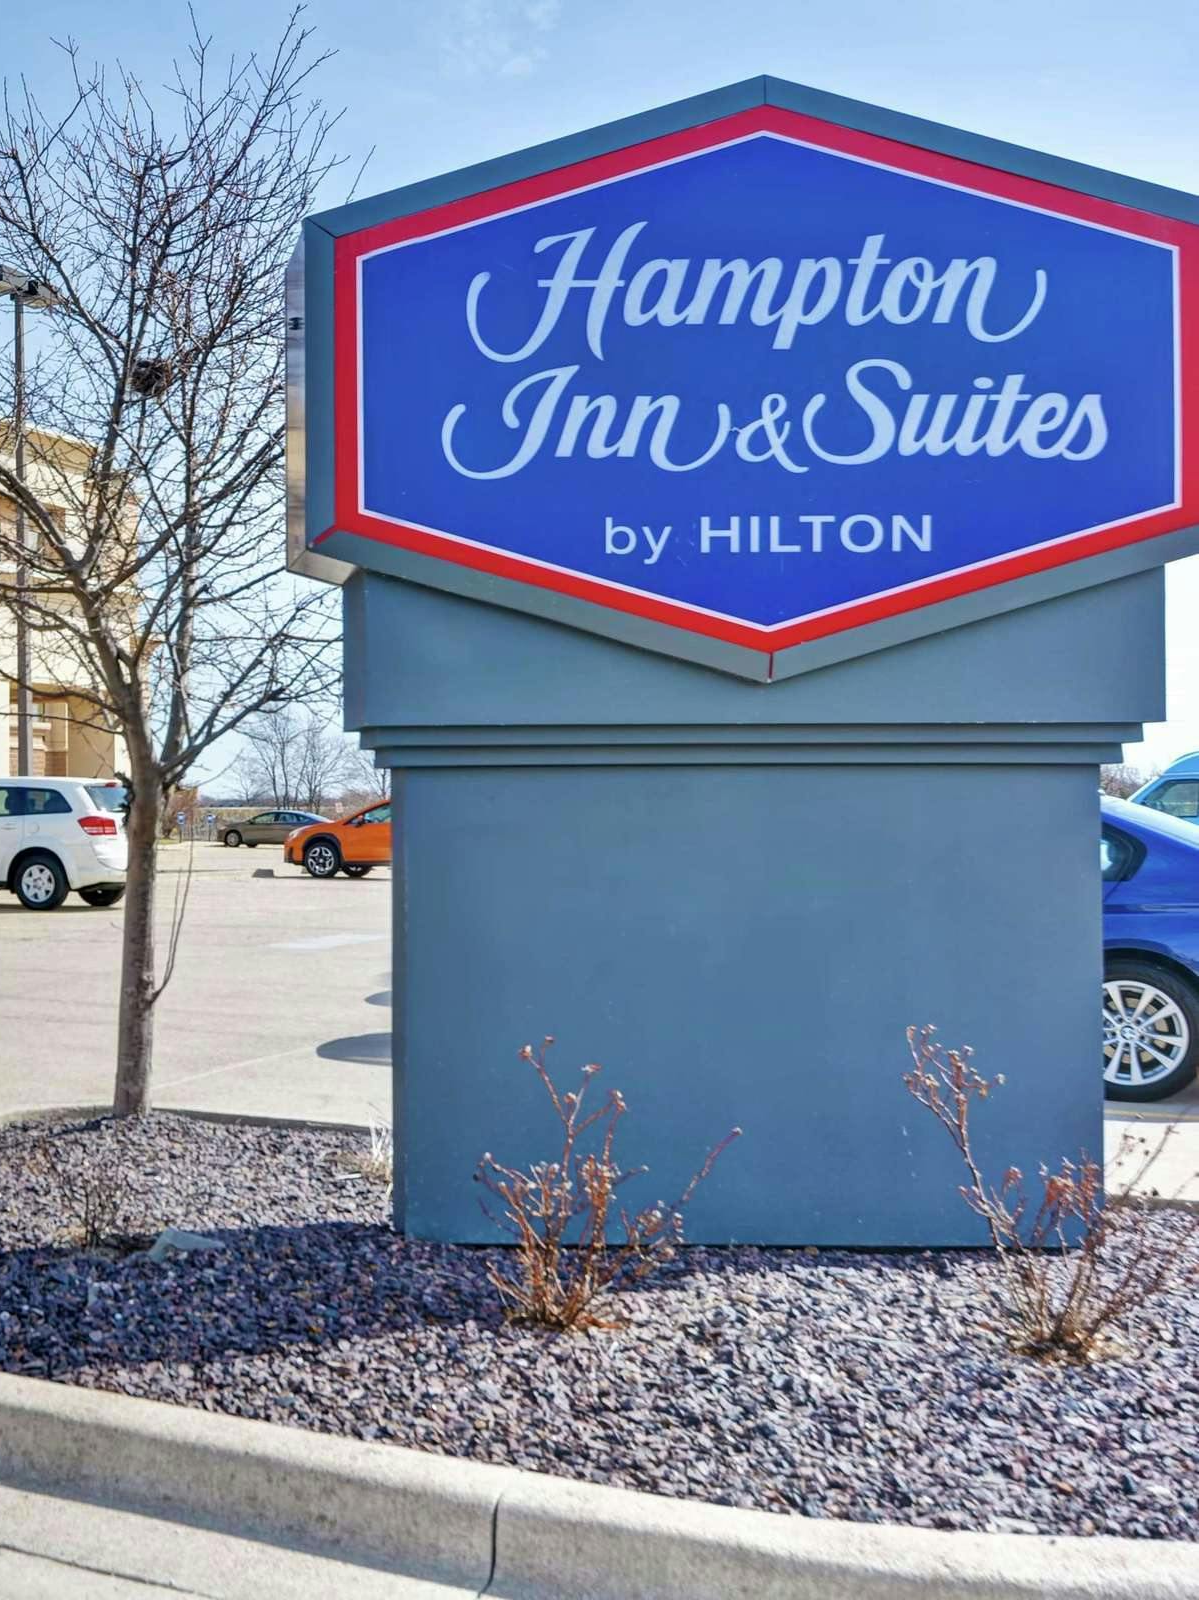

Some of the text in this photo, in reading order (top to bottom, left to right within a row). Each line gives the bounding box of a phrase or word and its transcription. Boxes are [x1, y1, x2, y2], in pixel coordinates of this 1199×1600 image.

[465, 220, 1047, 363] Hampton
[441, 358, 1109, 480] Inn & Suites
[604, 513, 933, 565] by HILTON
